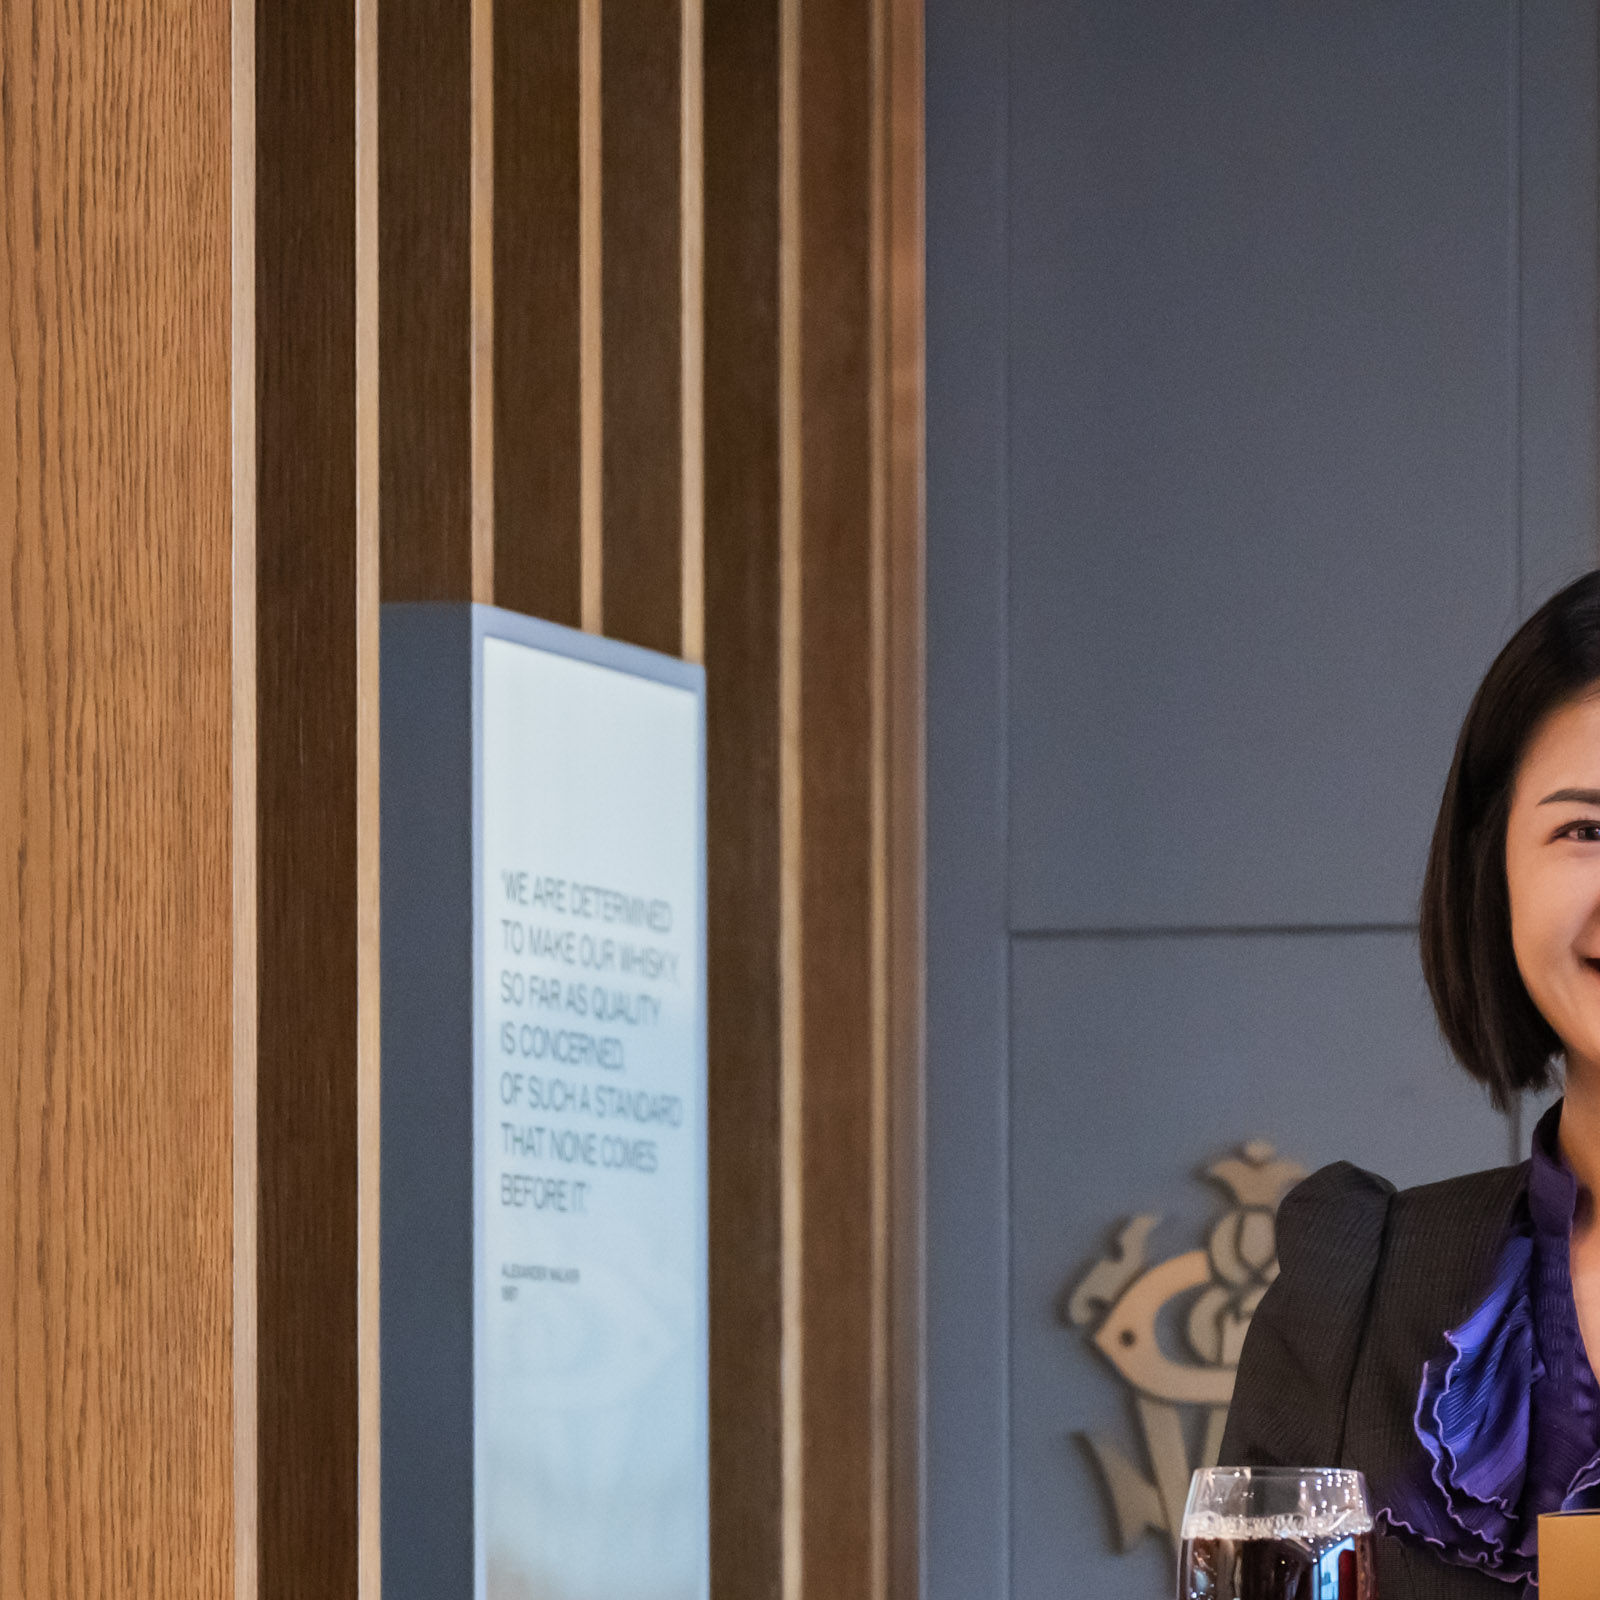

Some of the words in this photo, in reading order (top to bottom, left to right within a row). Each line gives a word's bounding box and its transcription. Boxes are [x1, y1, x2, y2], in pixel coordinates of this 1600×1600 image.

[534, 876, 567, 913] ARE
[571, 880, 673, 933] DETERMINED
[501, 918, 524, 956] TO
[529, 925, 577, 965] MAKE
[581, 933, 615, 970] OUR
[501, 969, 524, 1006] SO
[529, 975, 561, 1010] FAR
[567, 982, 588, 1016] AS
[592, 985, 662, 1026] QUALITY
[502, 1021, 515, 1055] IS
[501, 1071, 523, 1105] OF
[528, 1075, 576, 1112] SUCH
[580, 1083, 591, 1113] A
[596, 1083, 683, 1128] STANDARD
[501, 1121, 545, 1157] THAT
[551, 1127, 598, 1166] NONE
[602, 1133, 659, 1174] COMES
[501, 1173, 568, 1213] BEFORE
